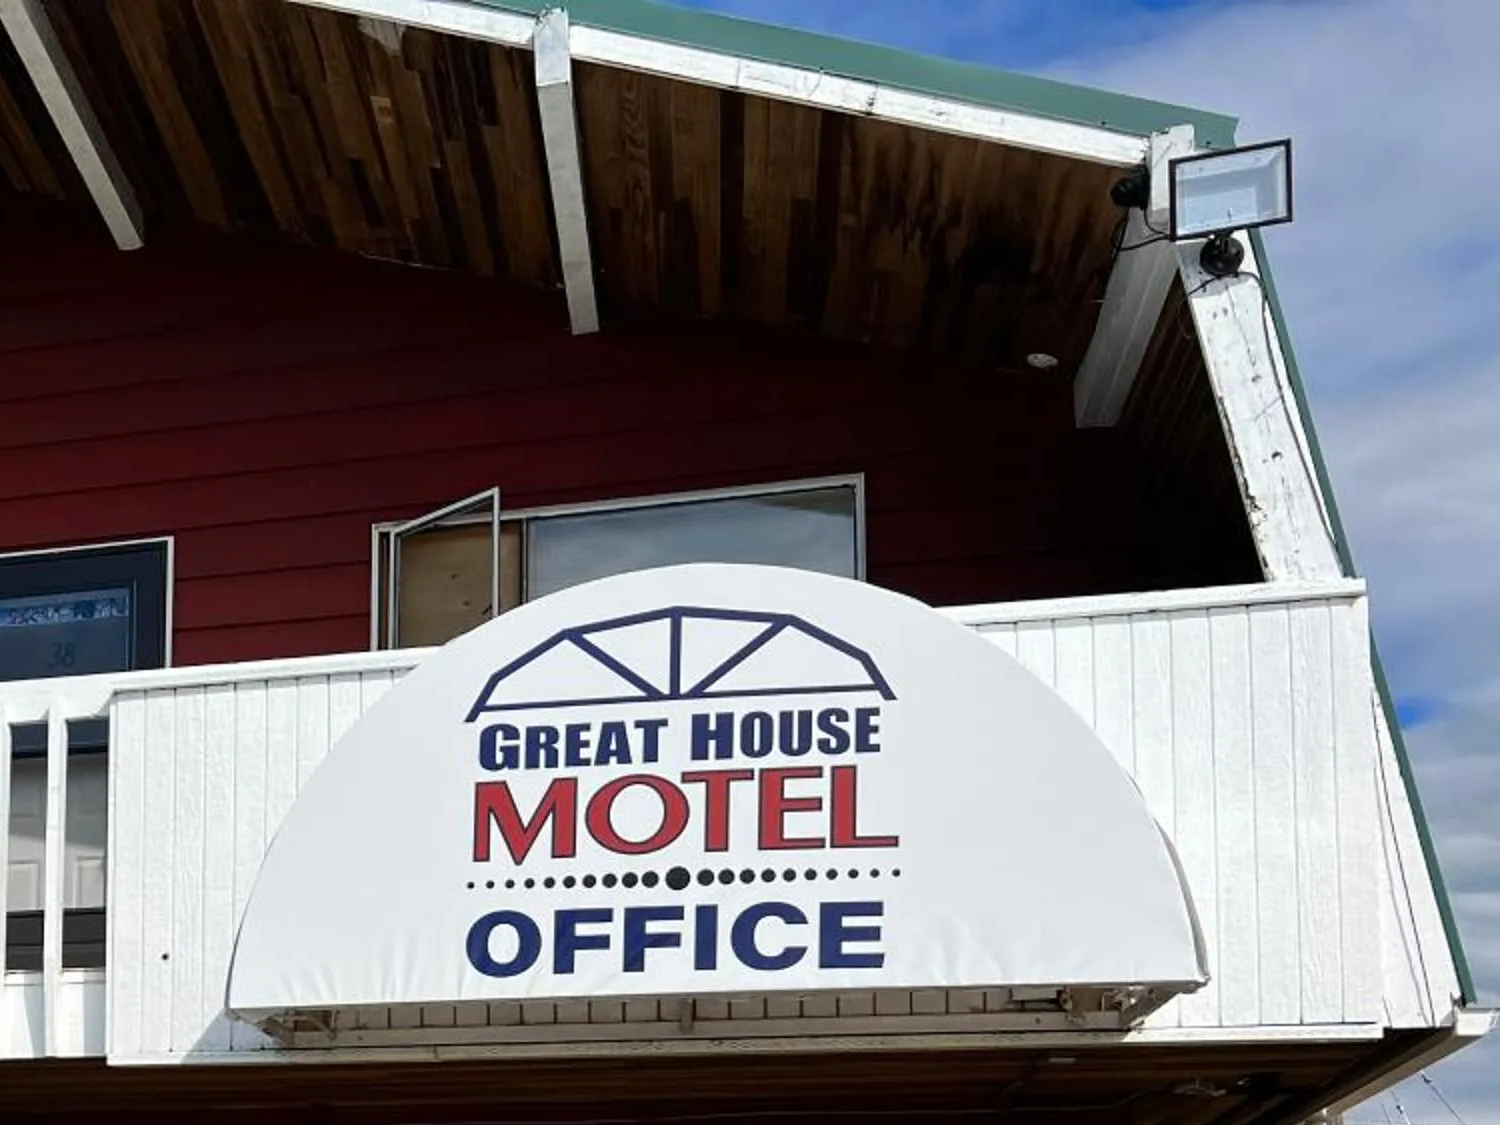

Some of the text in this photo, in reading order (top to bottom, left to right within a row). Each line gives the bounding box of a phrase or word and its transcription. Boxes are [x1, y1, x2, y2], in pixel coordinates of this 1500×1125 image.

[478, 706, 881, 771] GREAT HOUSE
[472, 765, 900, 866] MOTEL
[465, 900, 886, 978] OFFICE
